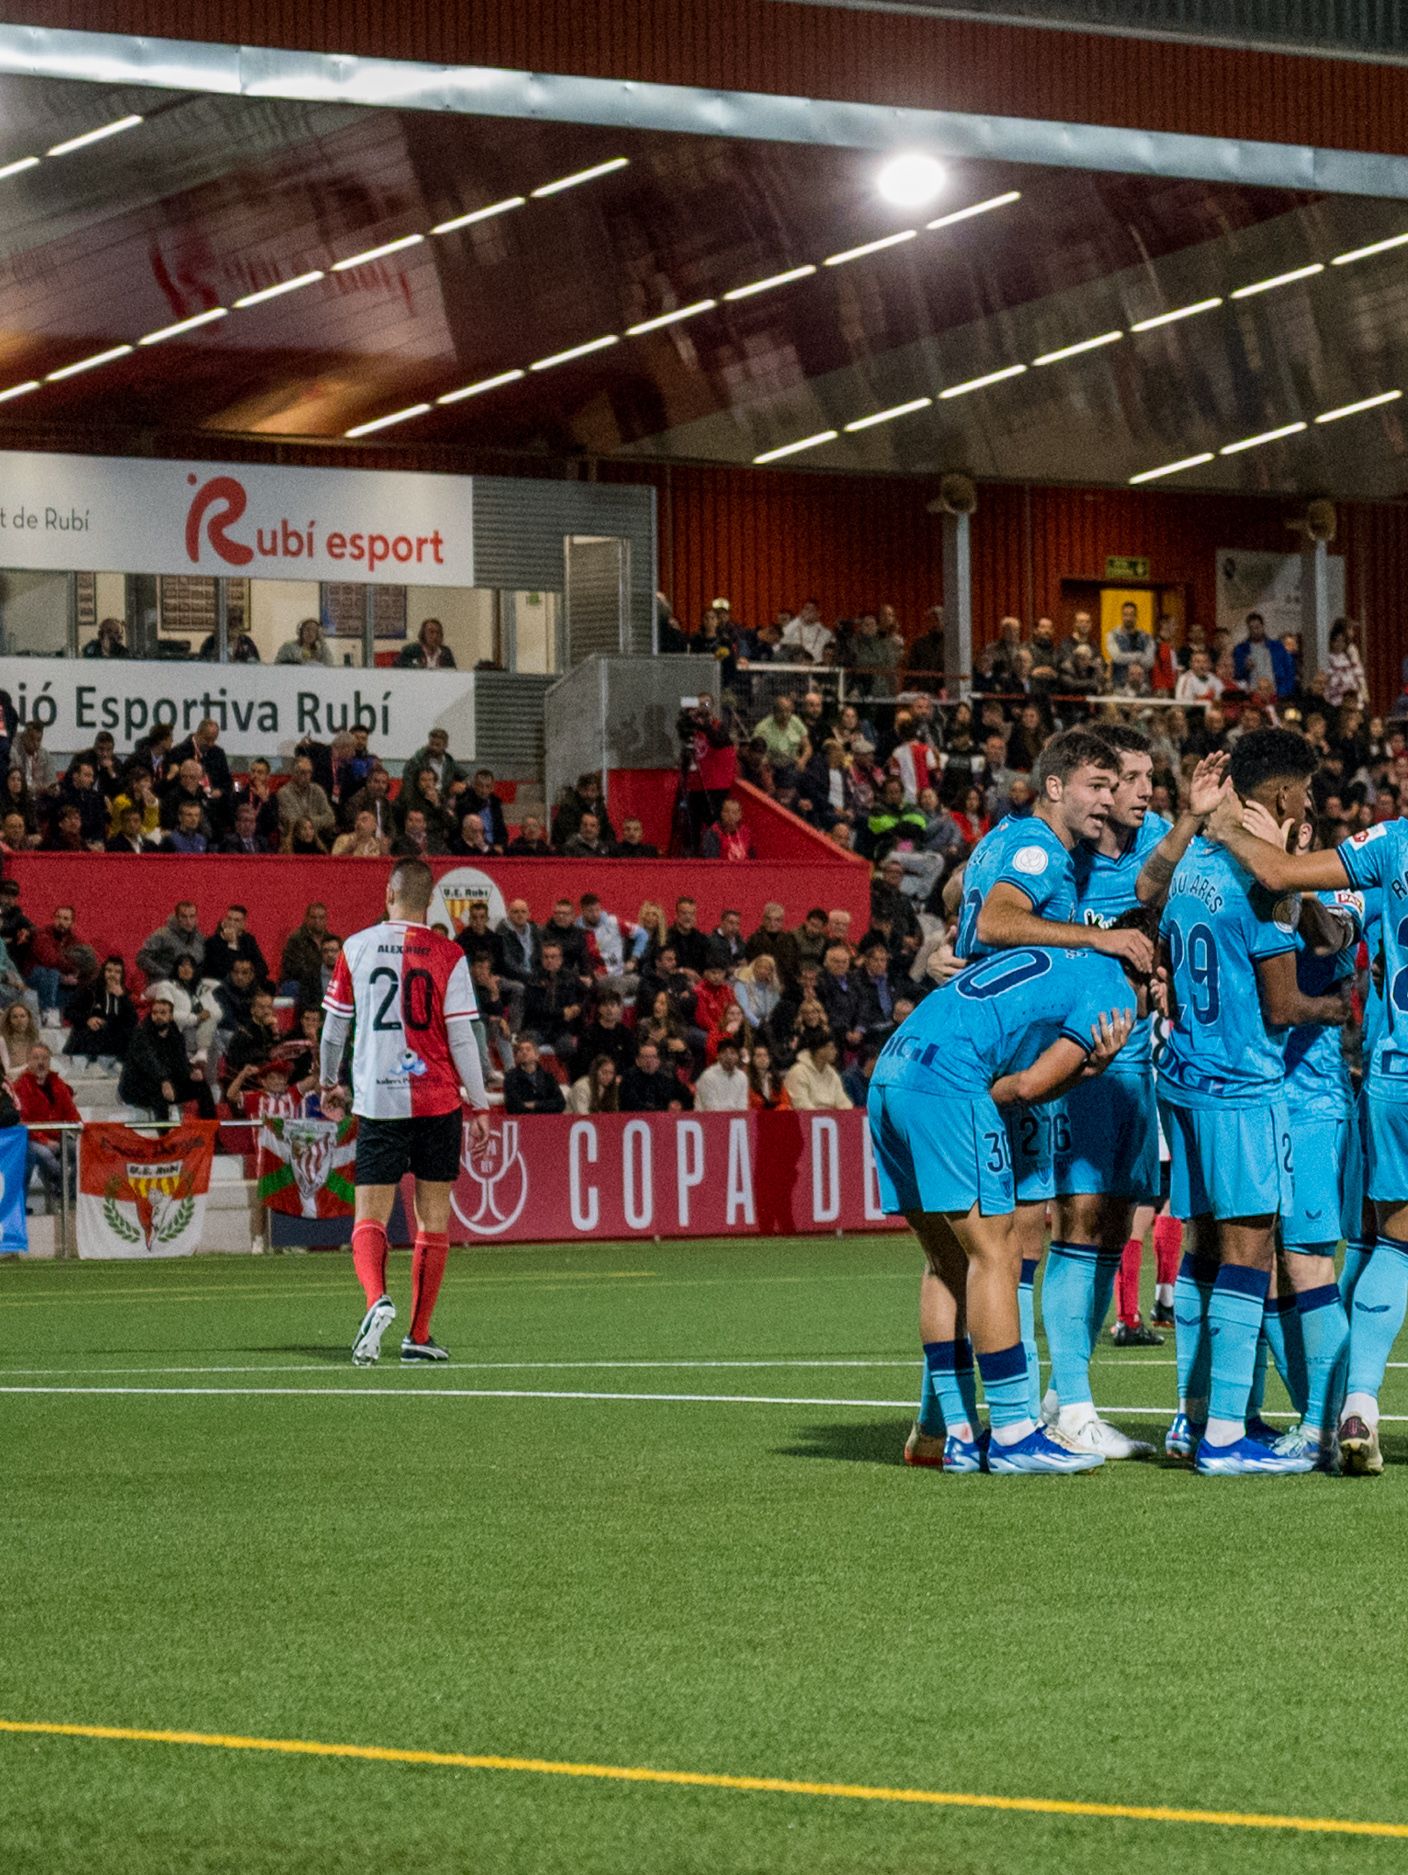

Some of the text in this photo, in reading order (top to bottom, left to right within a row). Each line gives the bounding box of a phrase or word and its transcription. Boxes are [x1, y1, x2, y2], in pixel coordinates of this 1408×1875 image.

[13, 506, 38, 529] de
[45, 507, 90, 531] Rubí
[326, 530, 444, 571] esport
[18, 682, 391, 740] ió Esportiva Rubí
[1190, 874, 1223, 914] ARES
[377, 945, 402, 954] ALEX
[369, 966, 434, 1031] 20
[1281, 1132, 1294, 1174] 2
[569, 1117, 757, 1232] COPA
